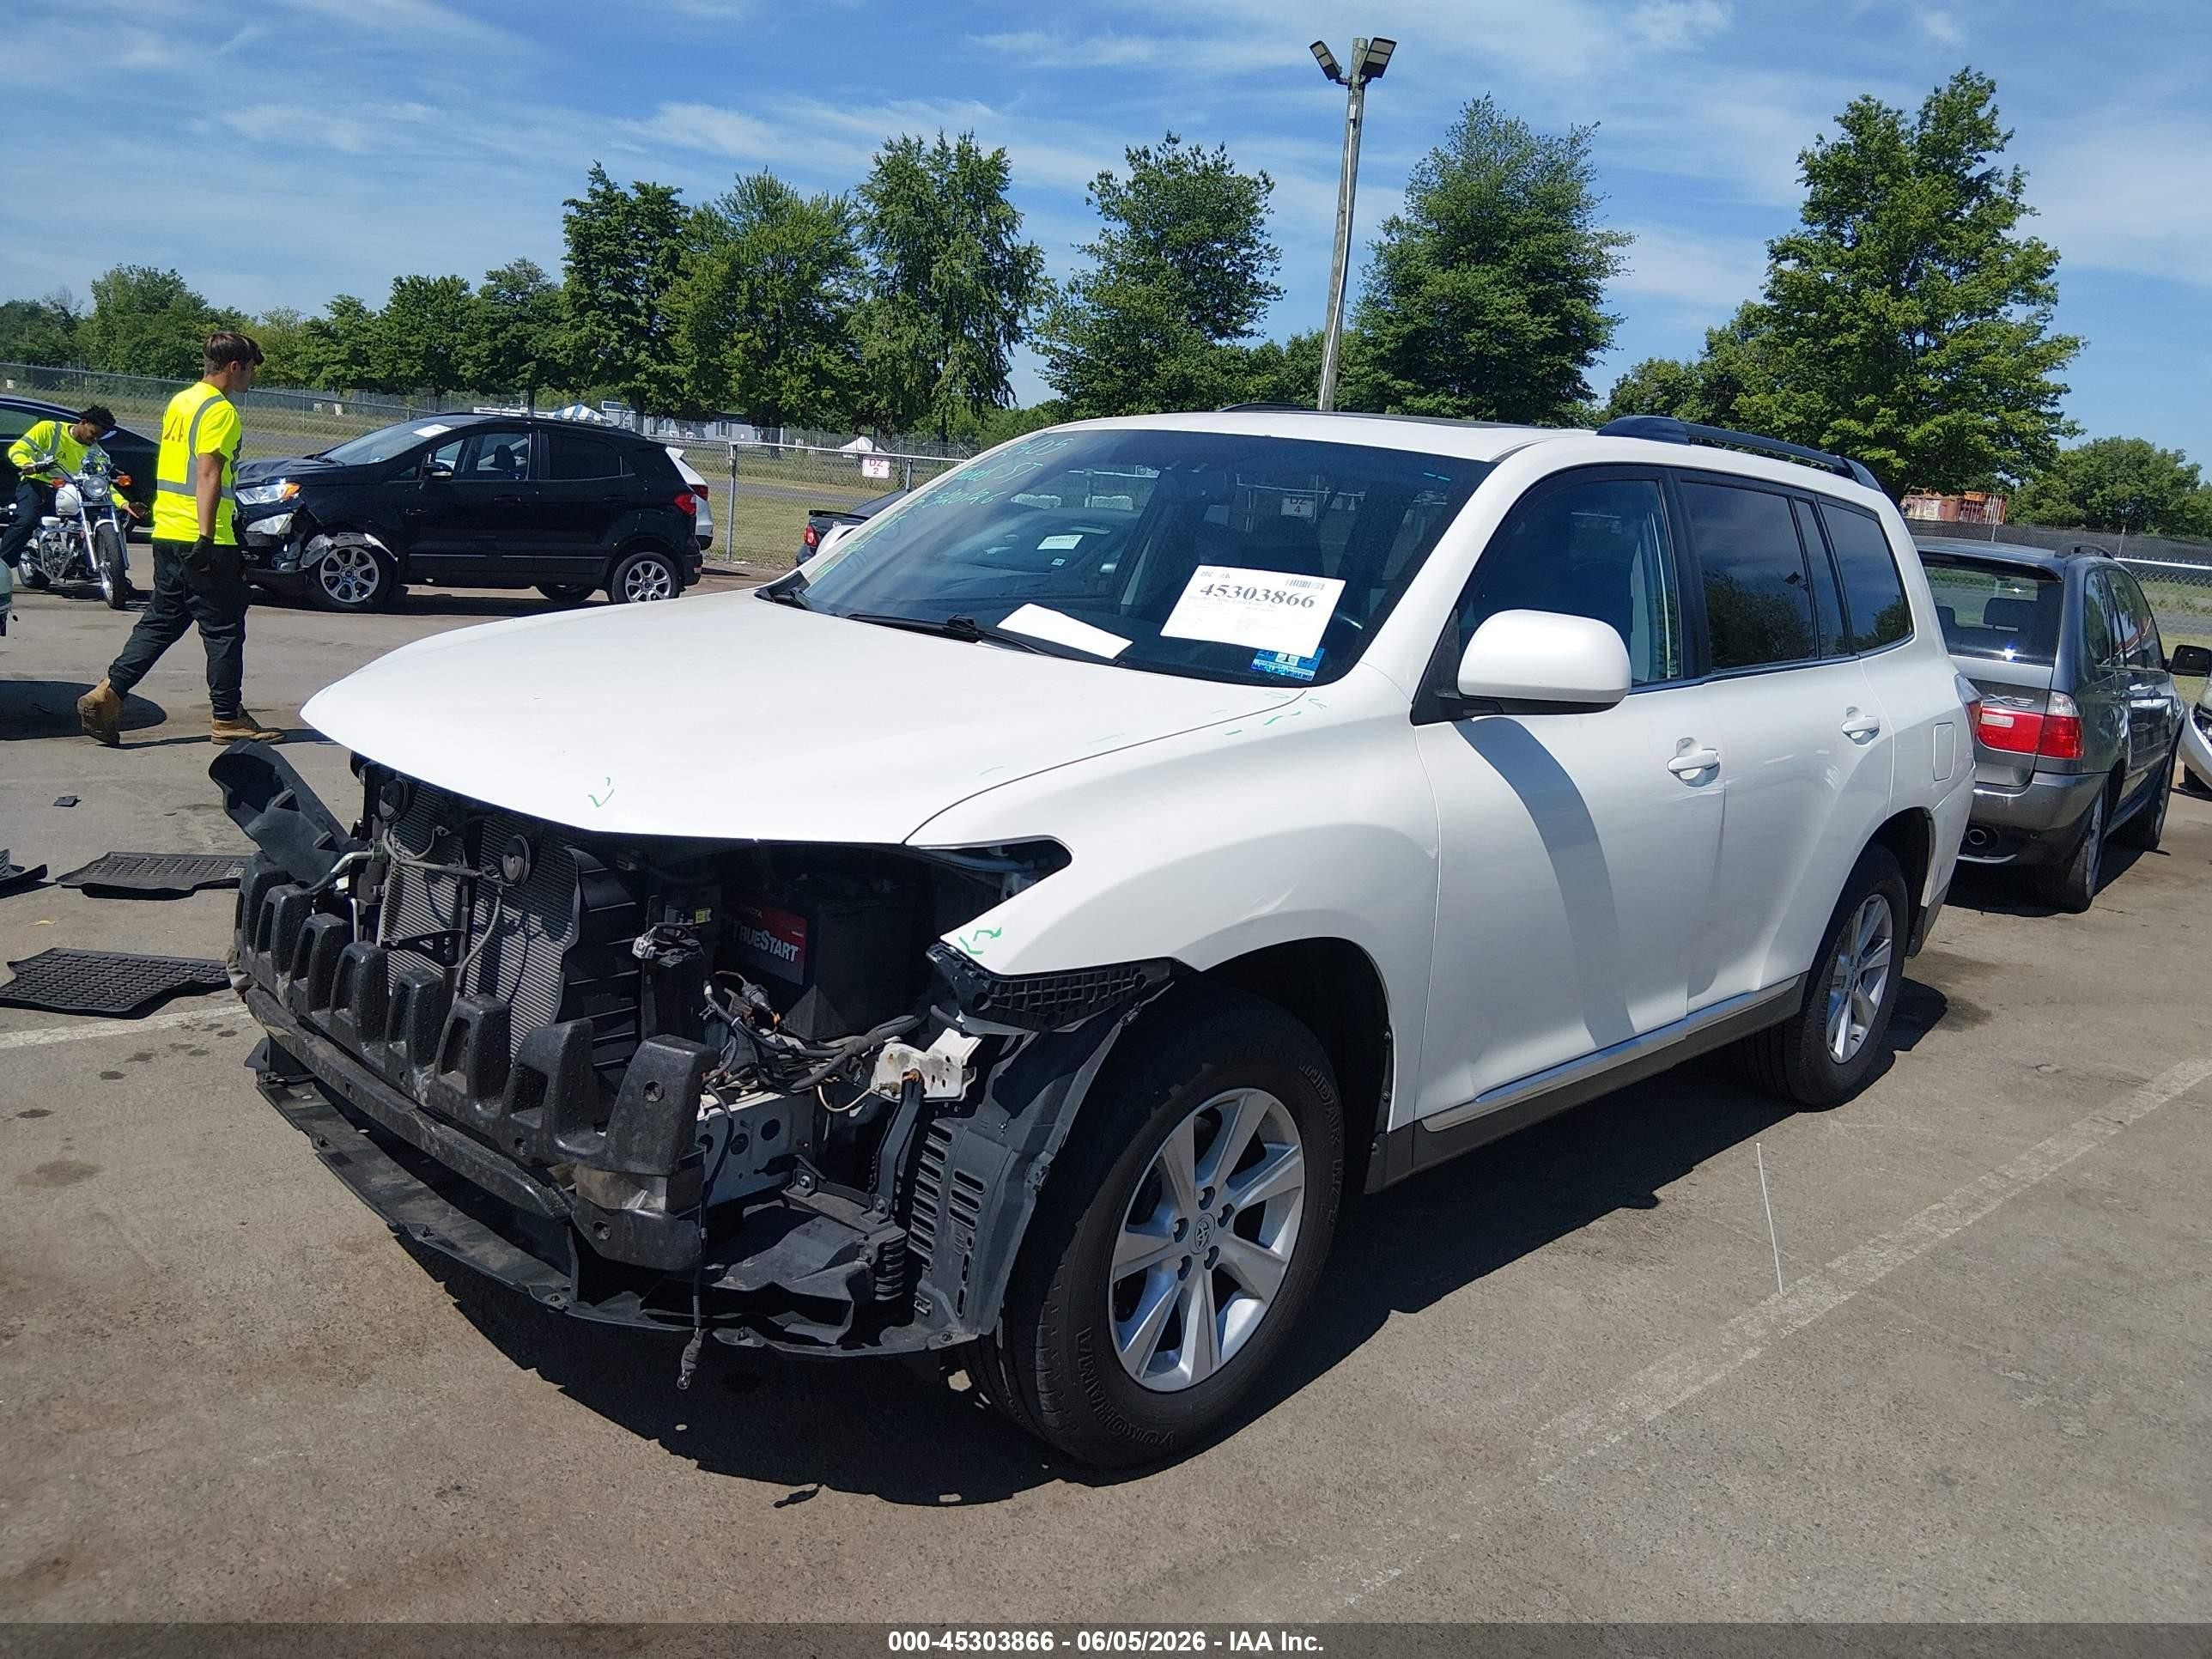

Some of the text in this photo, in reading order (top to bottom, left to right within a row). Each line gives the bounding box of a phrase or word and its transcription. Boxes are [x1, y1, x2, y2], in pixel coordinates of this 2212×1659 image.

[1293, 505, 1302, 514] 4
[1199, 583, 1317, 609] 45303866
[1984, 693, 2034, 708] X5
